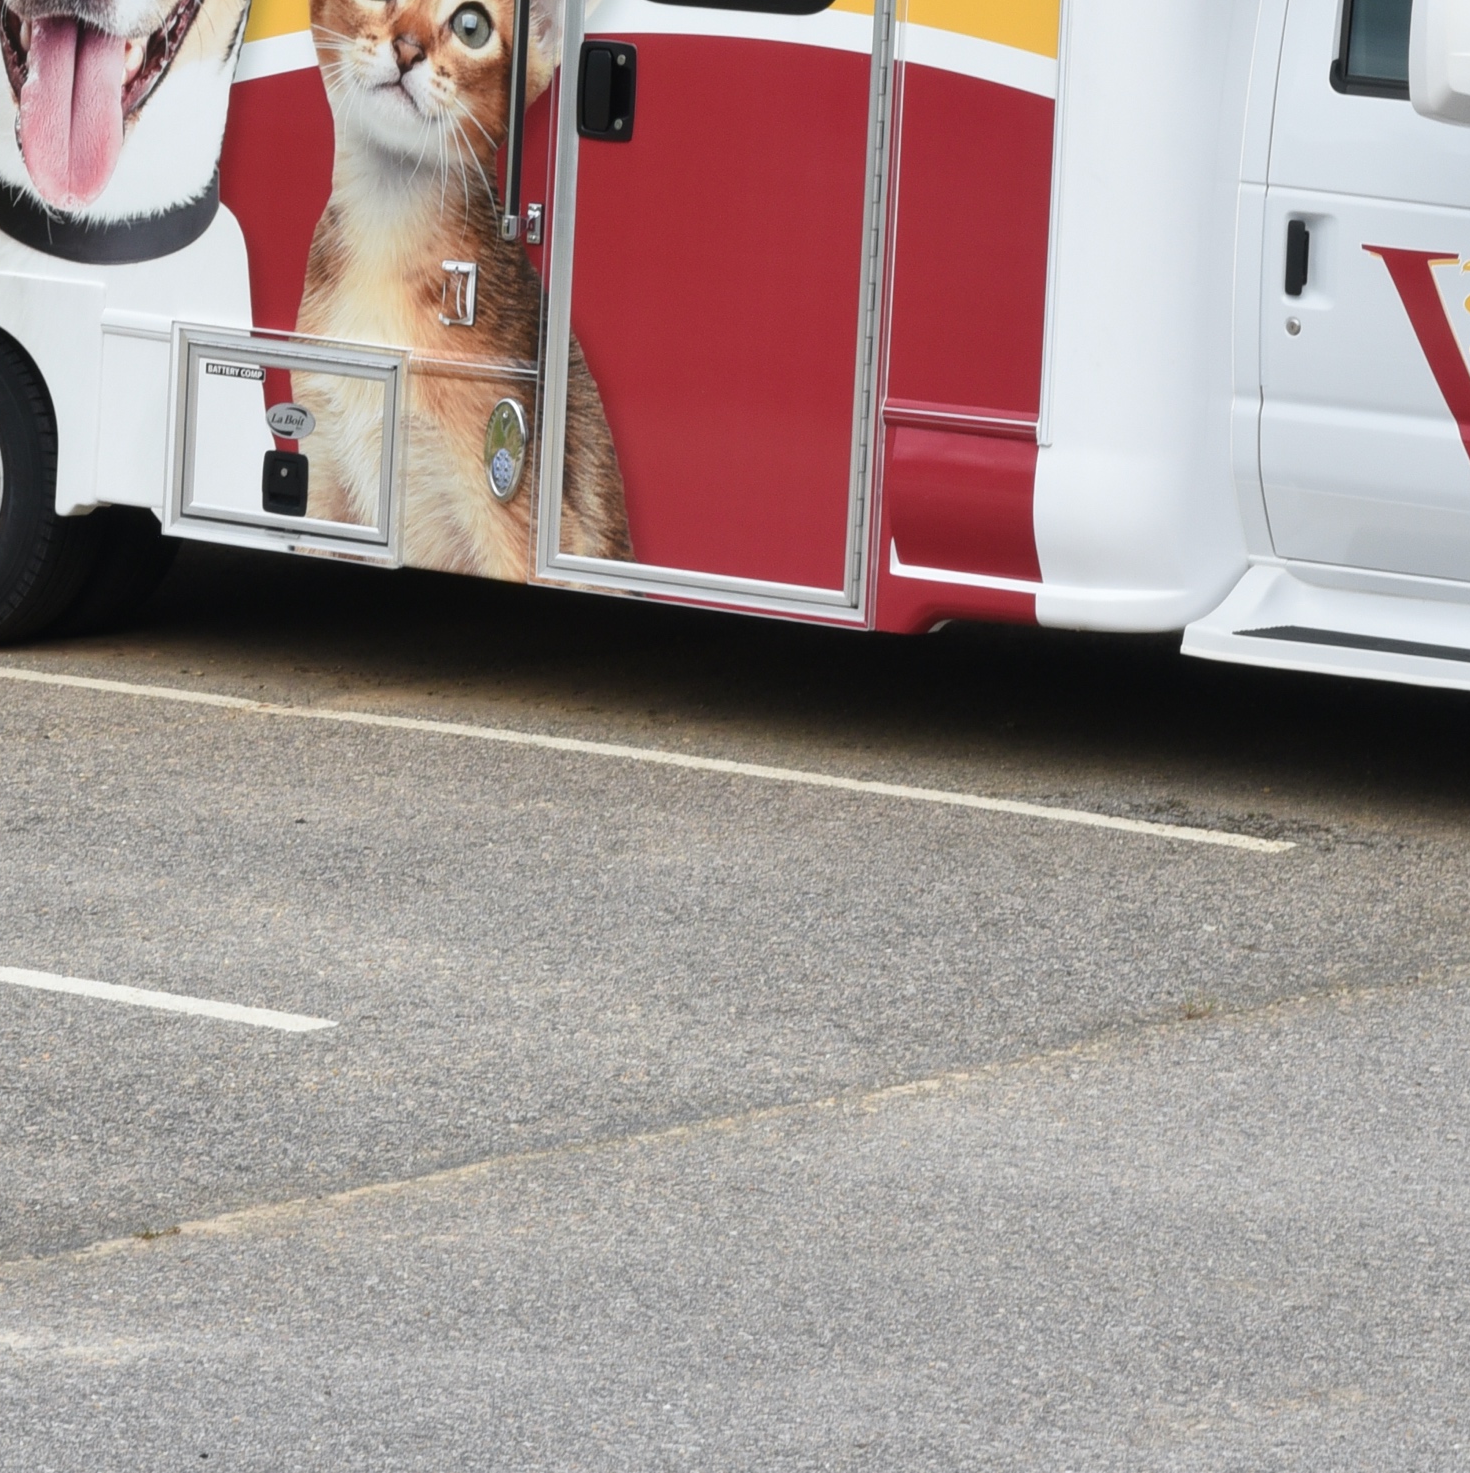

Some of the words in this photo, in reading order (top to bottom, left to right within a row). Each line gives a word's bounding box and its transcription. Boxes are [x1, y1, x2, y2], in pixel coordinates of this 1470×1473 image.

[207, 364, 239, 377] BATTERY
[240, 368, 263, 379] COMP
[271, 413, 283, 424] La
